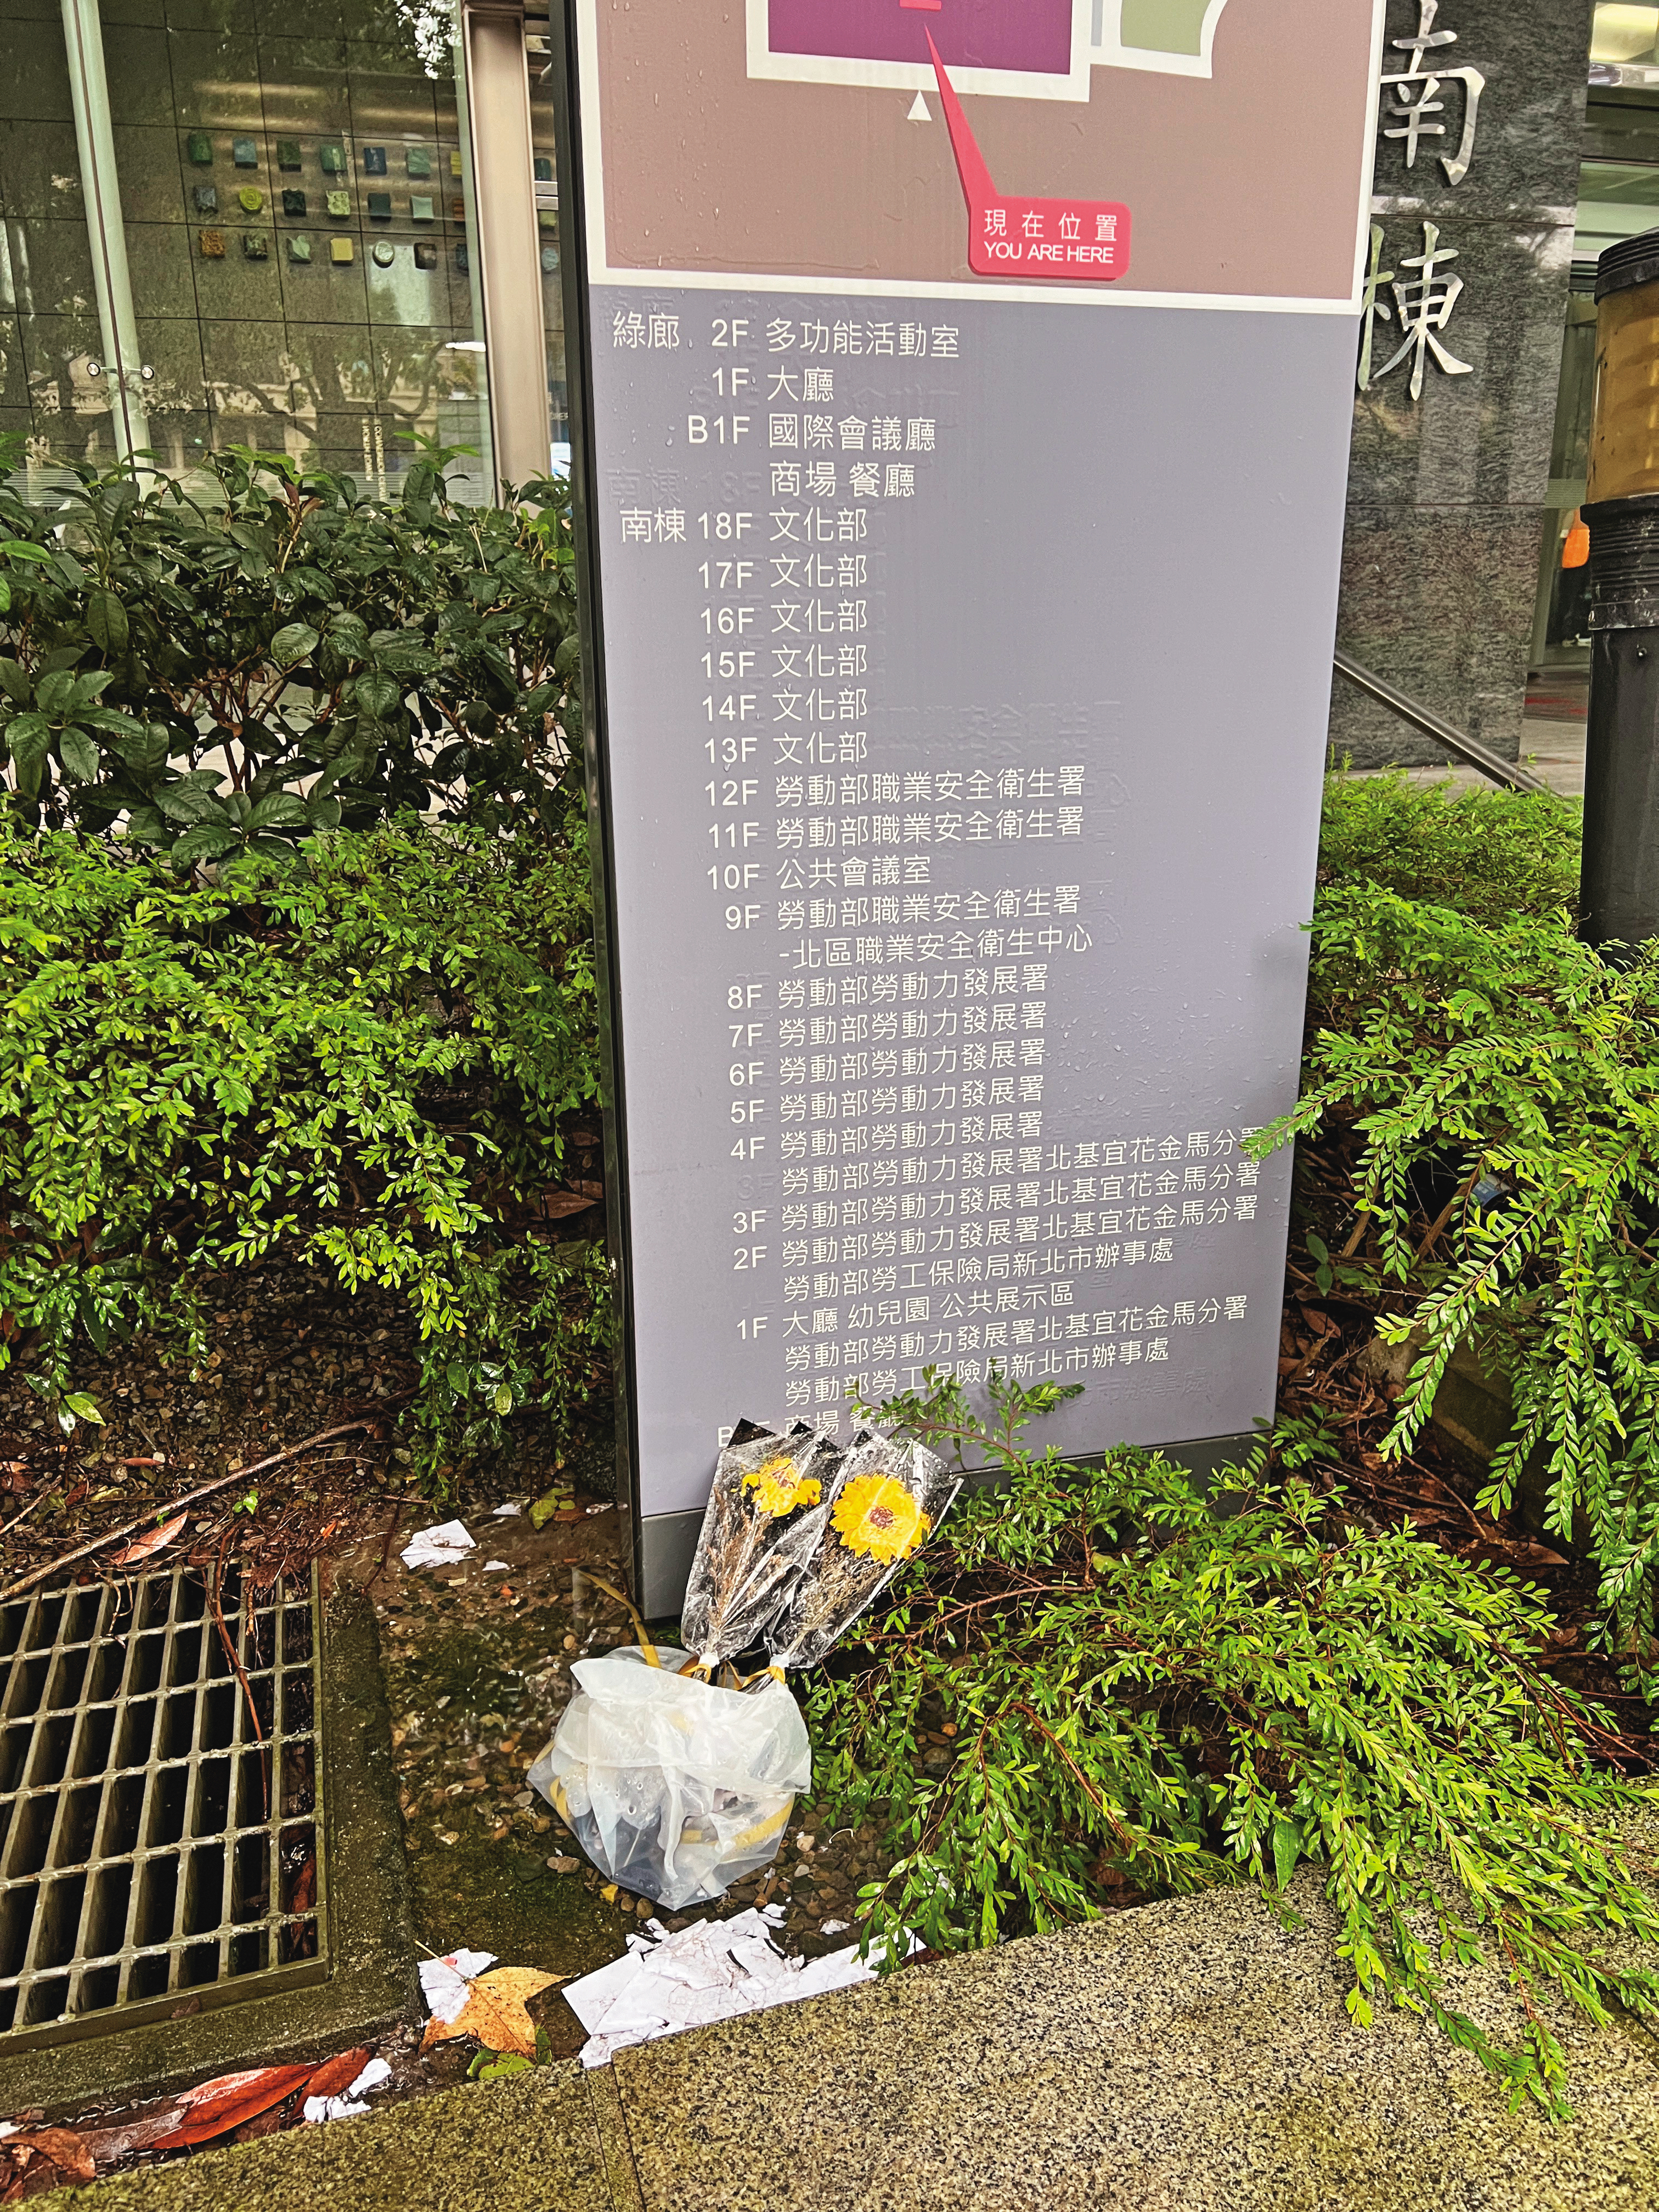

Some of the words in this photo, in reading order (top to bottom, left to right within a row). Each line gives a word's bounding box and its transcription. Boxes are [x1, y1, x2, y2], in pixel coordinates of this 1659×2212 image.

[1357, 0, 1485, 401] 南棟
[984, 210, 1118, 241] 現在位置
[984, 241, 1022, 259] YOU
[1028, 244, 1063, 261] ARE
[1067, 245, 1114, 263] HERE
[613, 311, 679, 349] 綠廊
[712, 319, 749, 347] 2F
[766, 318, 959, 357] 多功能活動室
[713, 368, 749, 396] 1F
[768, 365, 833, 402] 大廳
[689, 415, 750, 444] B1F
[770, 414, 935, 451] 國際會議廳
[770, 460, 836, 496] 商場
[849, 462, 915, 497] 餐廳
[620, 507, 686, 543] 南棟
[698, 512, 752, 539] 18F
[769, 507, 866, 541] 文化部
[699, 562, 753, 588] 17F
[770, 553, 866, 587] 文化部
[701, 608, 754, 634] 16F
[771, 599, 866, 633] 文化部
[702, 652, 755, 678] 15F
[772, 644, 866, 677] 文化部
[703, 695, 756, 721] 14F
[772, 689, 867, 721] 文化部
[705, 737, 757, 763] 13F
[774, 731, 867, 764] 文化部
[706, 780, 758, 806] 12F
[776, 766, 1085, 807] 勞動部職業安全衛生署
[709, 822, 759, 848] 11F
[777, 806, 1084, 849] 勞動部職業安全衛生署
[708, 864, 759, 889] 10F
[776, 854, 930, 889] 公共會議室
[726, 905, 760, 929] 9F
[778, 885, 1080, 930] 勞動部職業安全衛生署
[780, 924, 1092, 969] -北區職業安全衛生中心
[728, 985, 762, 1009] 8F
[779, 964, 1048, 1009] 勞動部勞動力發展署
[729, 1024, 763, 1047] 7F
[780, 1002, 1046, 1047] 勞動部勞動力發展署
[730, 1062, 764, 1086] 6F
[780, 1039, 1045, 1085] 勞動部勞動力發展署
[731, 1099, 764, 1123] 5F
[781, 1075, 1044, 1122] 勞動部勞動力發展署
[731, 1137, 765, 1160] 4F
[781, 1111, 1042, 1159] 勞動部勞動力發展署
[733, 1210, 766, 1233] 3F
[782, 1161, 1260, 1232] 勞動部勞動力發展署北基宜花金馬分署
[734, 1246, 767, 1269] 2F
[783, 1195, 1257, 1267] 勞動部勞動力發展署北基宜花金馬分署
[785, 1238, 1173, 1302] 勞動部勞工保險局新北市辦事處
[737, 1317, 768, 1339] 1F
[783, 1307, 838, 1337] 大廳
[848, 1296, 929, 1329] 幼兒園
[940, 1280, 1074, 1318] 公共展示區
[786, 1295, 1247, 1372] 勞動部勞動力發展署北基宜花金馬分署
